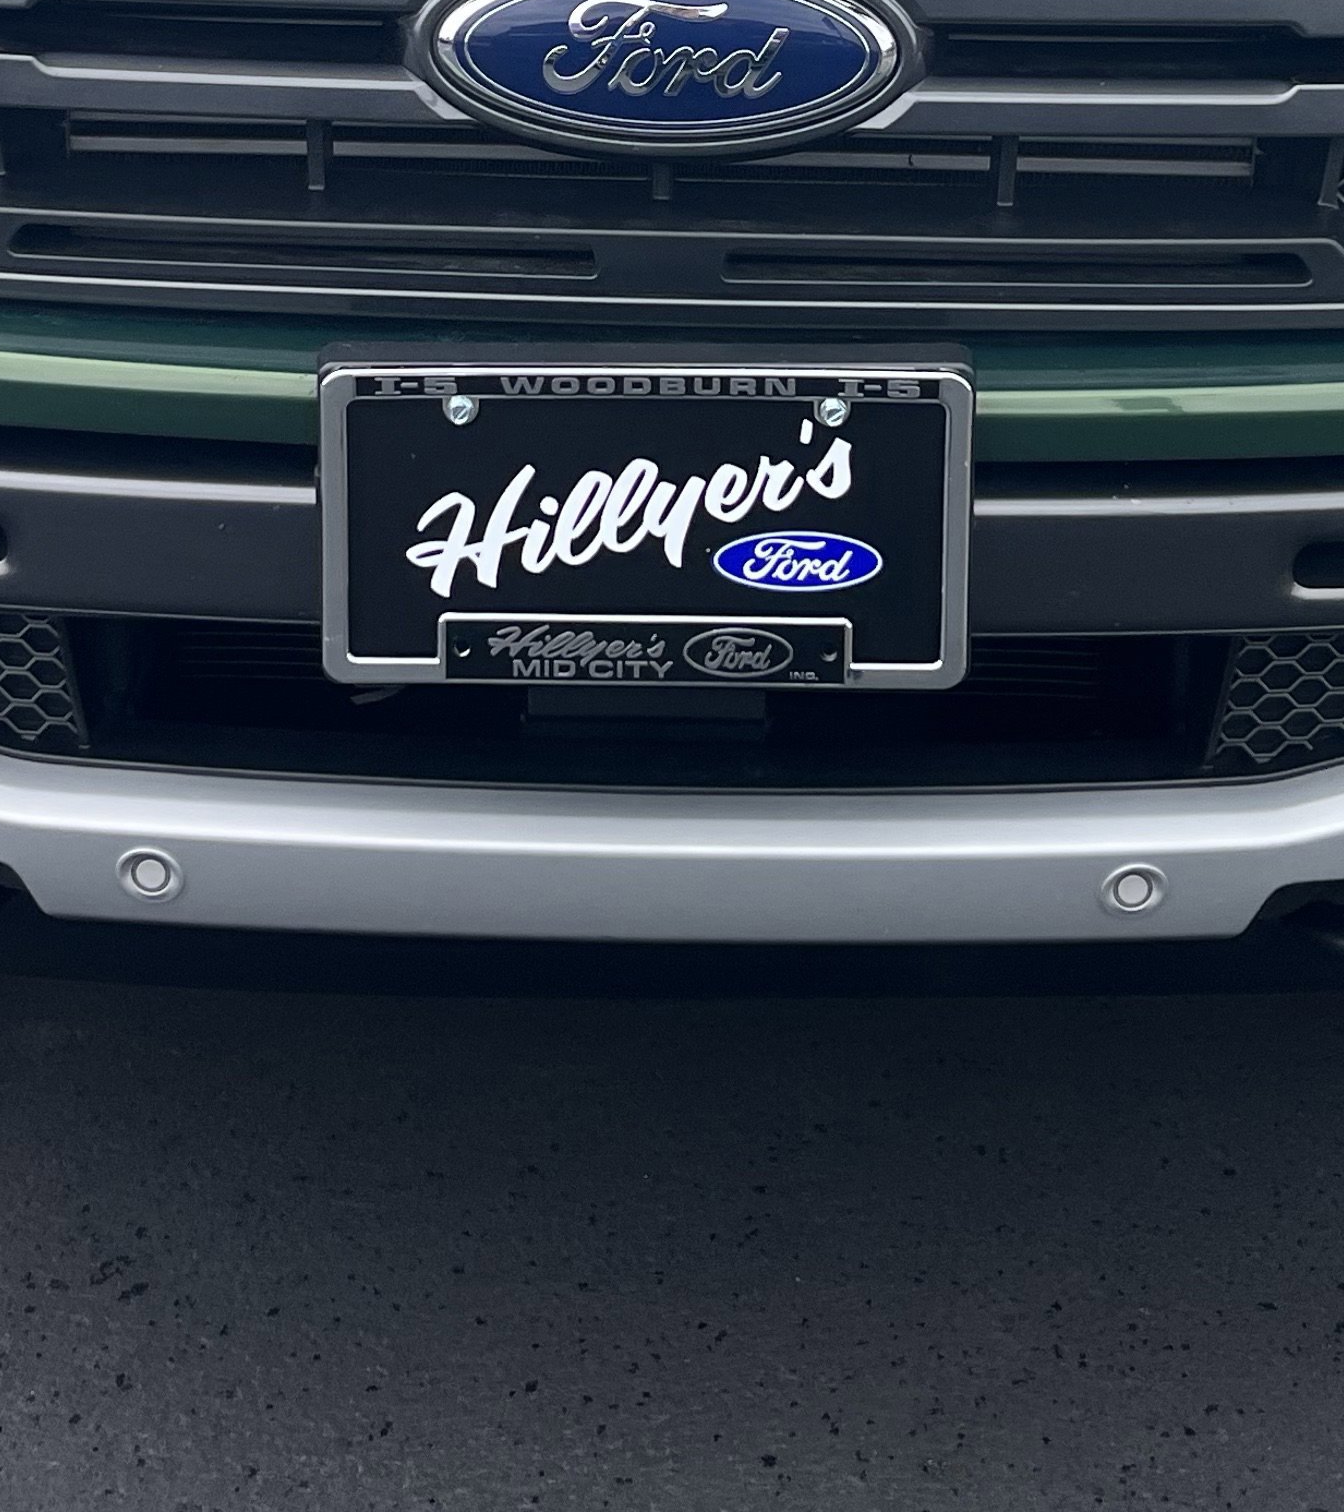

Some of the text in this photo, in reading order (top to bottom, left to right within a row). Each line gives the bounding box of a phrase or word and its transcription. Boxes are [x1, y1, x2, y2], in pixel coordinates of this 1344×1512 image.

[374, 376, 921, 398] I-5 WOODBURN I-5
[405, 419, 853, 598] Hillyer's
[742, 538, 854, 582] Ford
[488, 625, 772, 670] Hillyer's Ford
[512, 659, 674, 679] MID CITY
